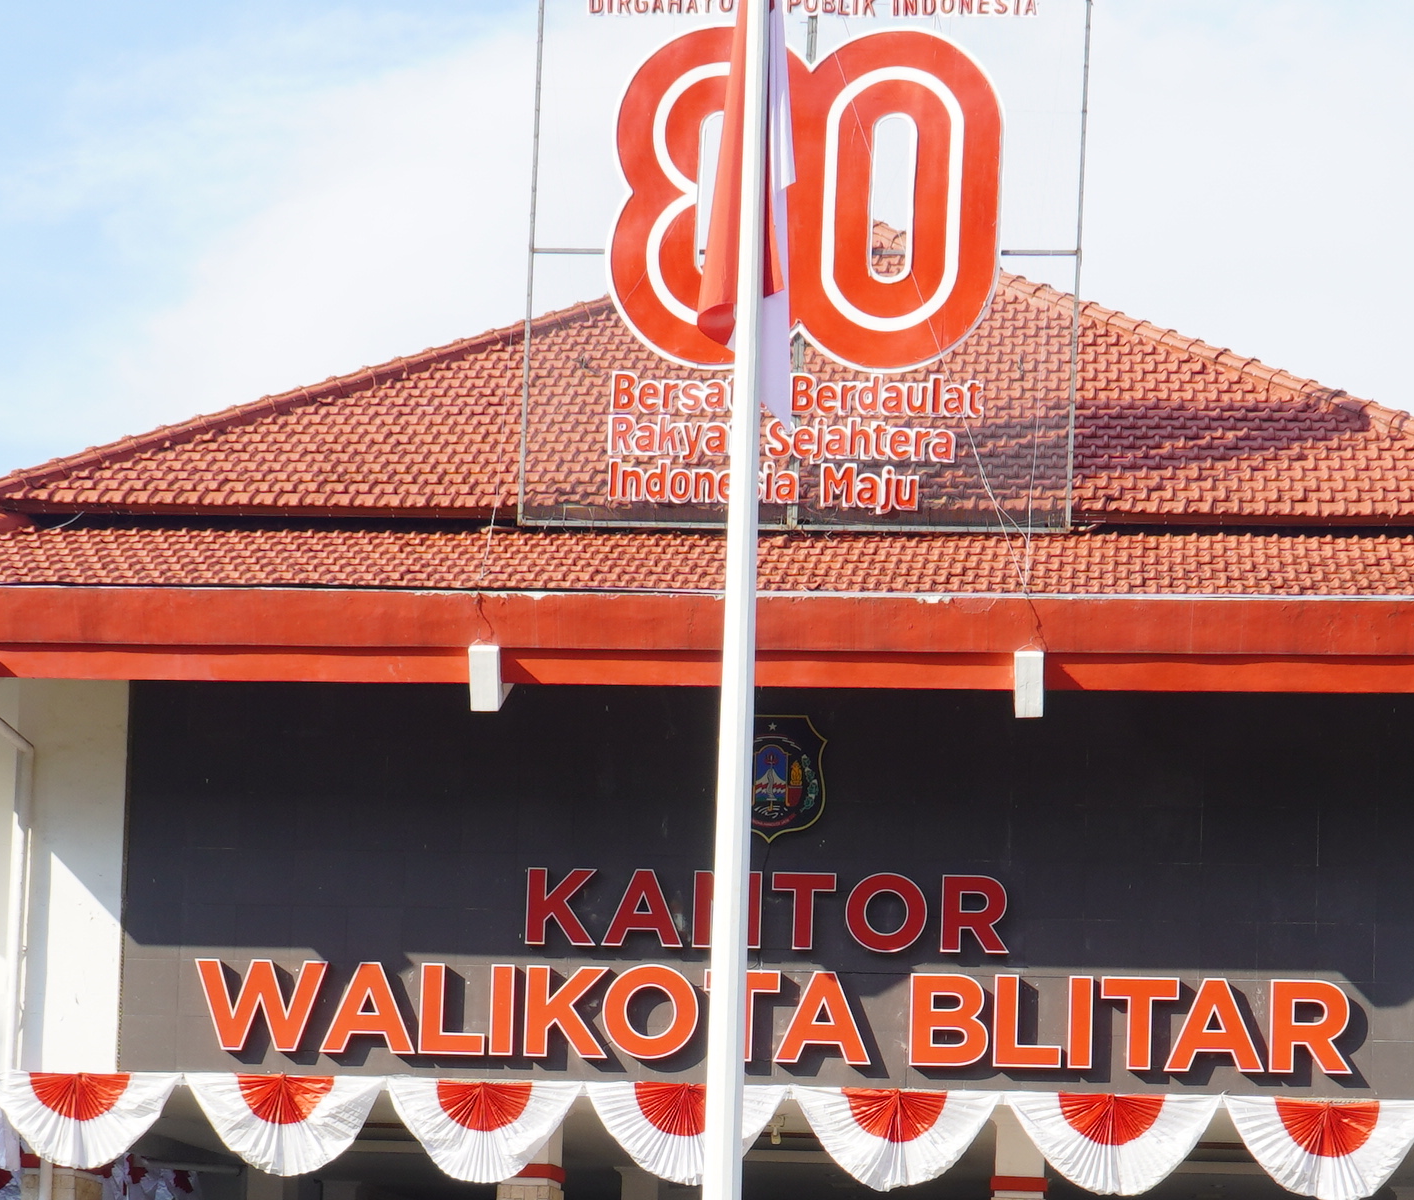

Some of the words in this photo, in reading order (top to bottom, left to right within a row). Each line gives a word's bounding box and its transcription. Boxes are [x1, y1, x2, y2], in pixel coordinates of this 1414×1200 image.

[786, 0, 875, 16] PUBLIK
[892, 0, 1037, 16] INDONESIA
[612, 372, 765, 412] Bersa
[790, 374, 983, 416] Berdaulat
[609, 415, 732, 461] Rakya
[766, 418, 955, 463] Sejahtera
[609, 460, 797, 502] Indoneia
[821, 463, 919, 514] Maju
[909, 973, 1353, 1075] BLITAR
